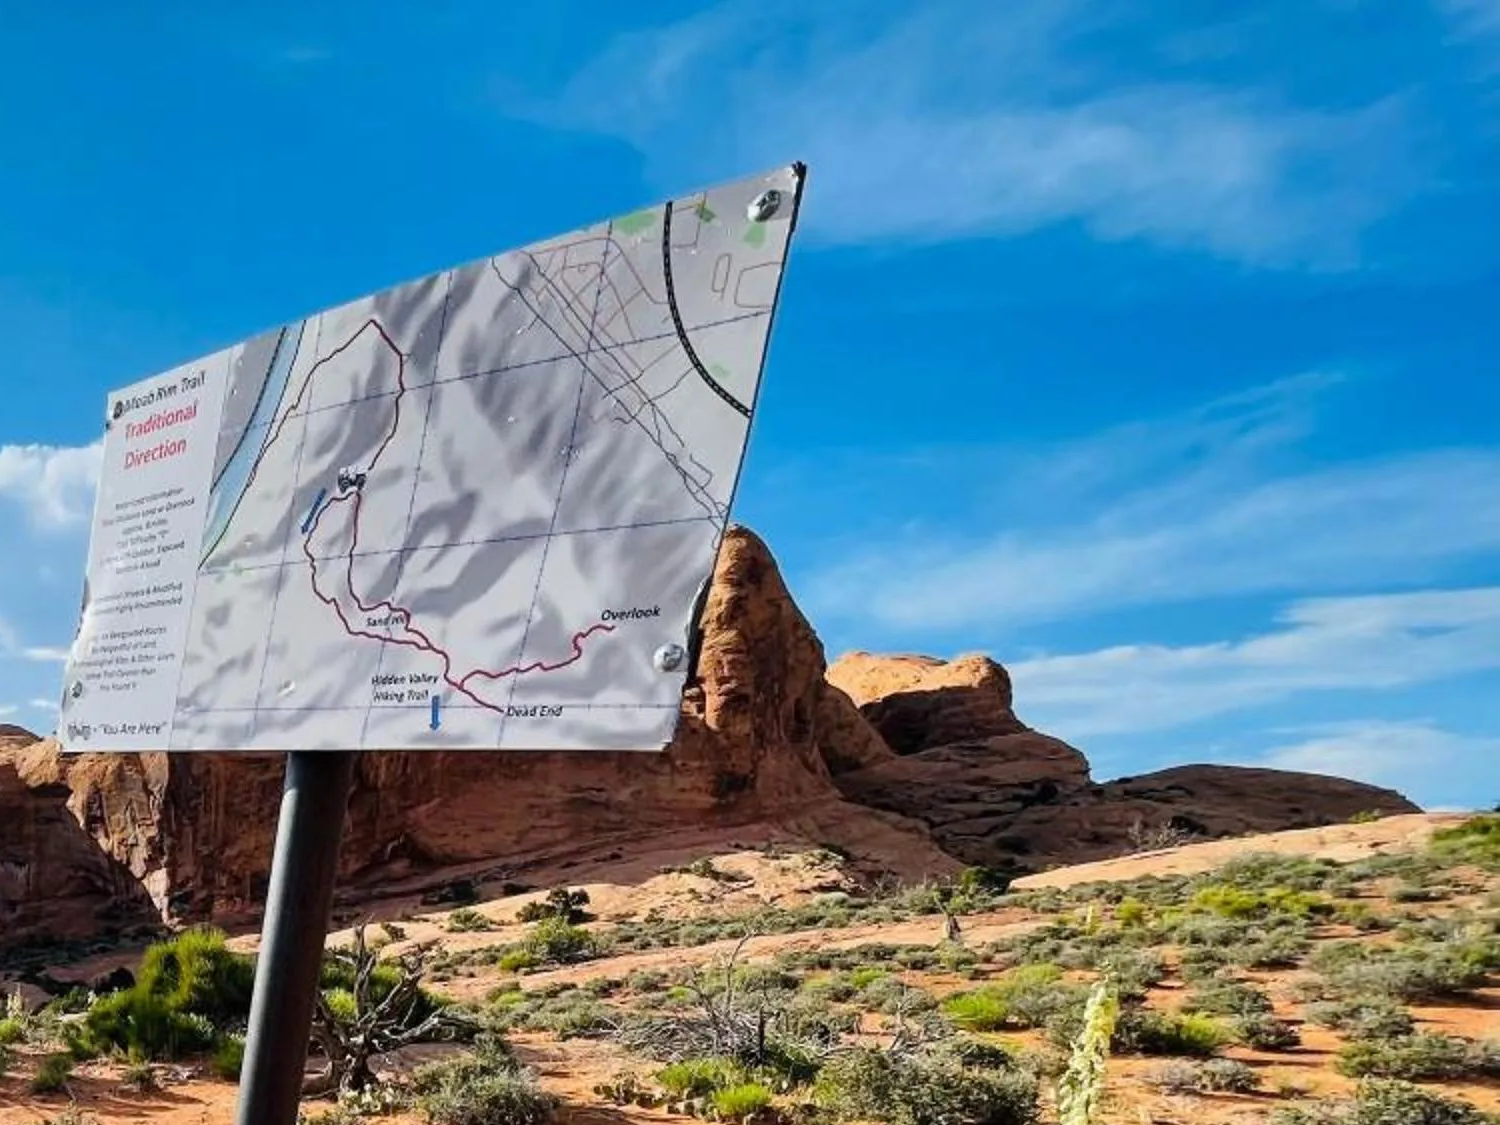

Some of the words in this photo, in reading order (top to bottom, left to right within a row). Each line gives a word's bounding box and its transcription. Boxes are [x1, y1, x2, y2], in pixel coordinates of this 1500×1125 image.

[156, 384, 178, 402] Rim
[181, 369, 206, 393] Trail
[125, 401, 198, 440] Traditional
[124, 439, 187, 470] Direction
[601, 605, 661, 622] Overlook
[371, 673, 406, 686] Hidden
[408, 671, 440, 685] Valley
[373, 690, 405, 704] Hiking
[407, 688, 429, 701] Trail
[506, 704, 537, 718] Dead
[539, 704, 563, 718] End
[120, 722, 138, 736] Are
